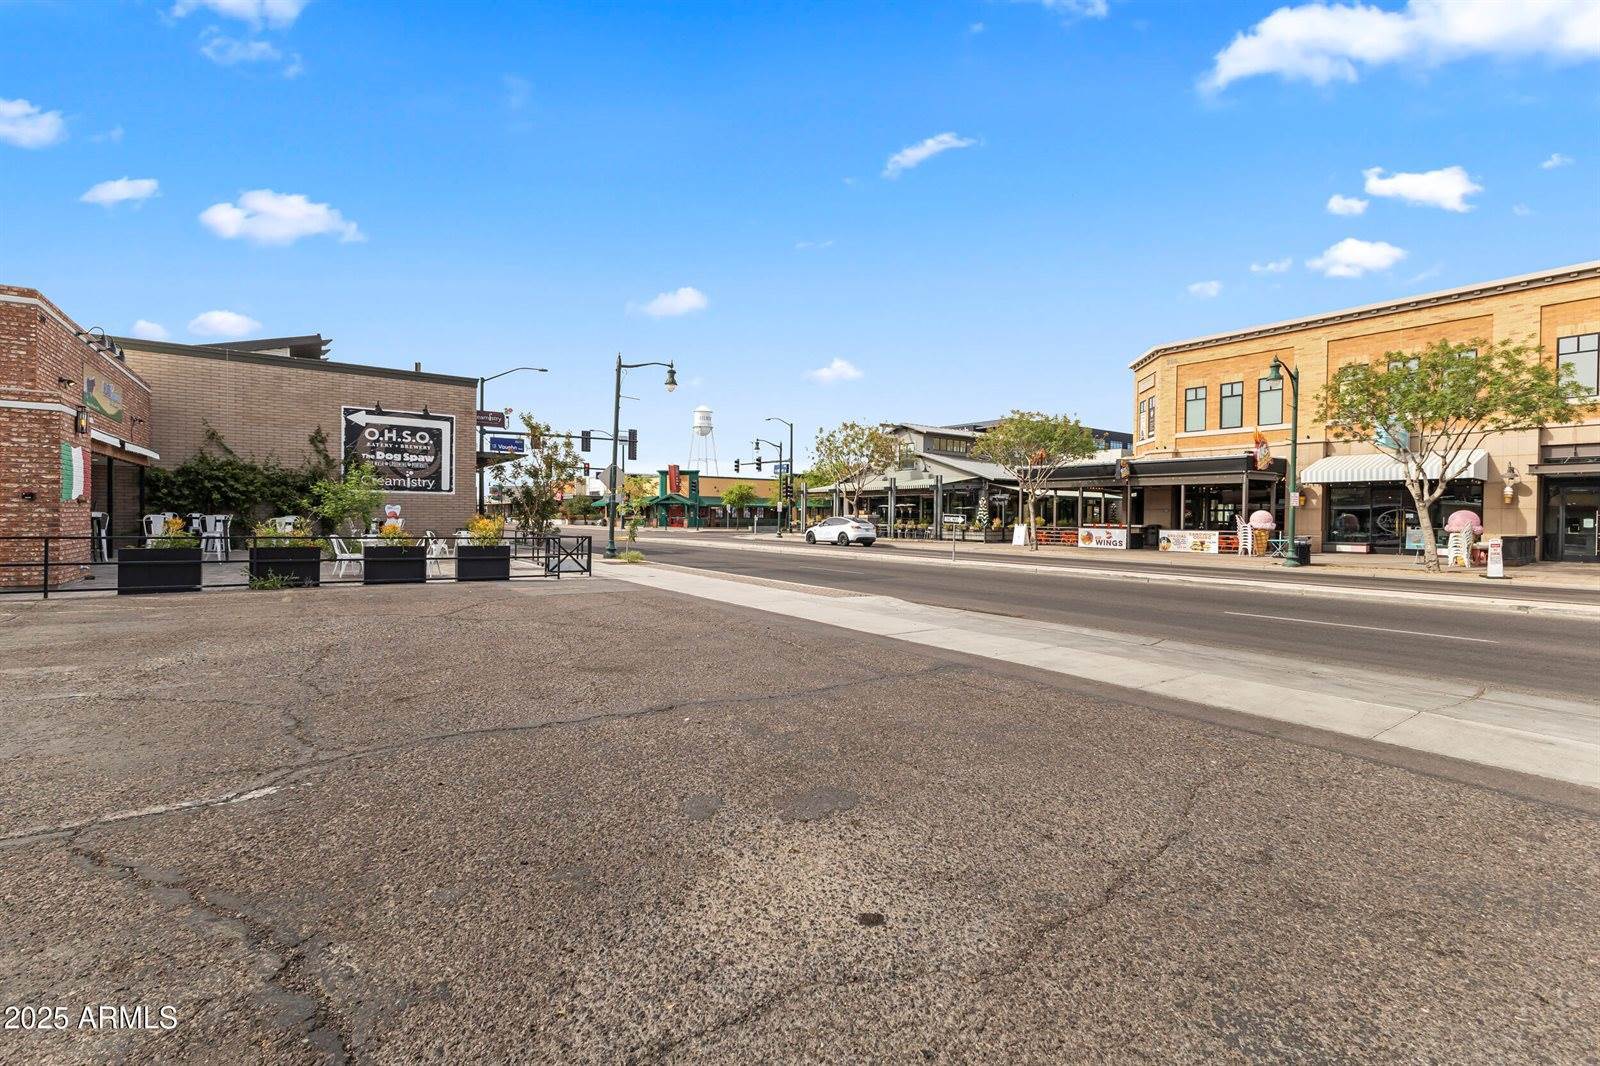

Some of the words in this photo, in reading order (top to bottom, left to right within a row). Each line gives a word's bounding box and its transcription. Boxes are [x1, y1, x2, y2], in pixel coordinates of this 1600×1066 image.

[364, 428, 433, 444] O.H.S.O.
[376, 451, 402, 462] Dog
[403, 452, 435, 463] Spaw
[1095, 539, 1124, 547] WINGS
